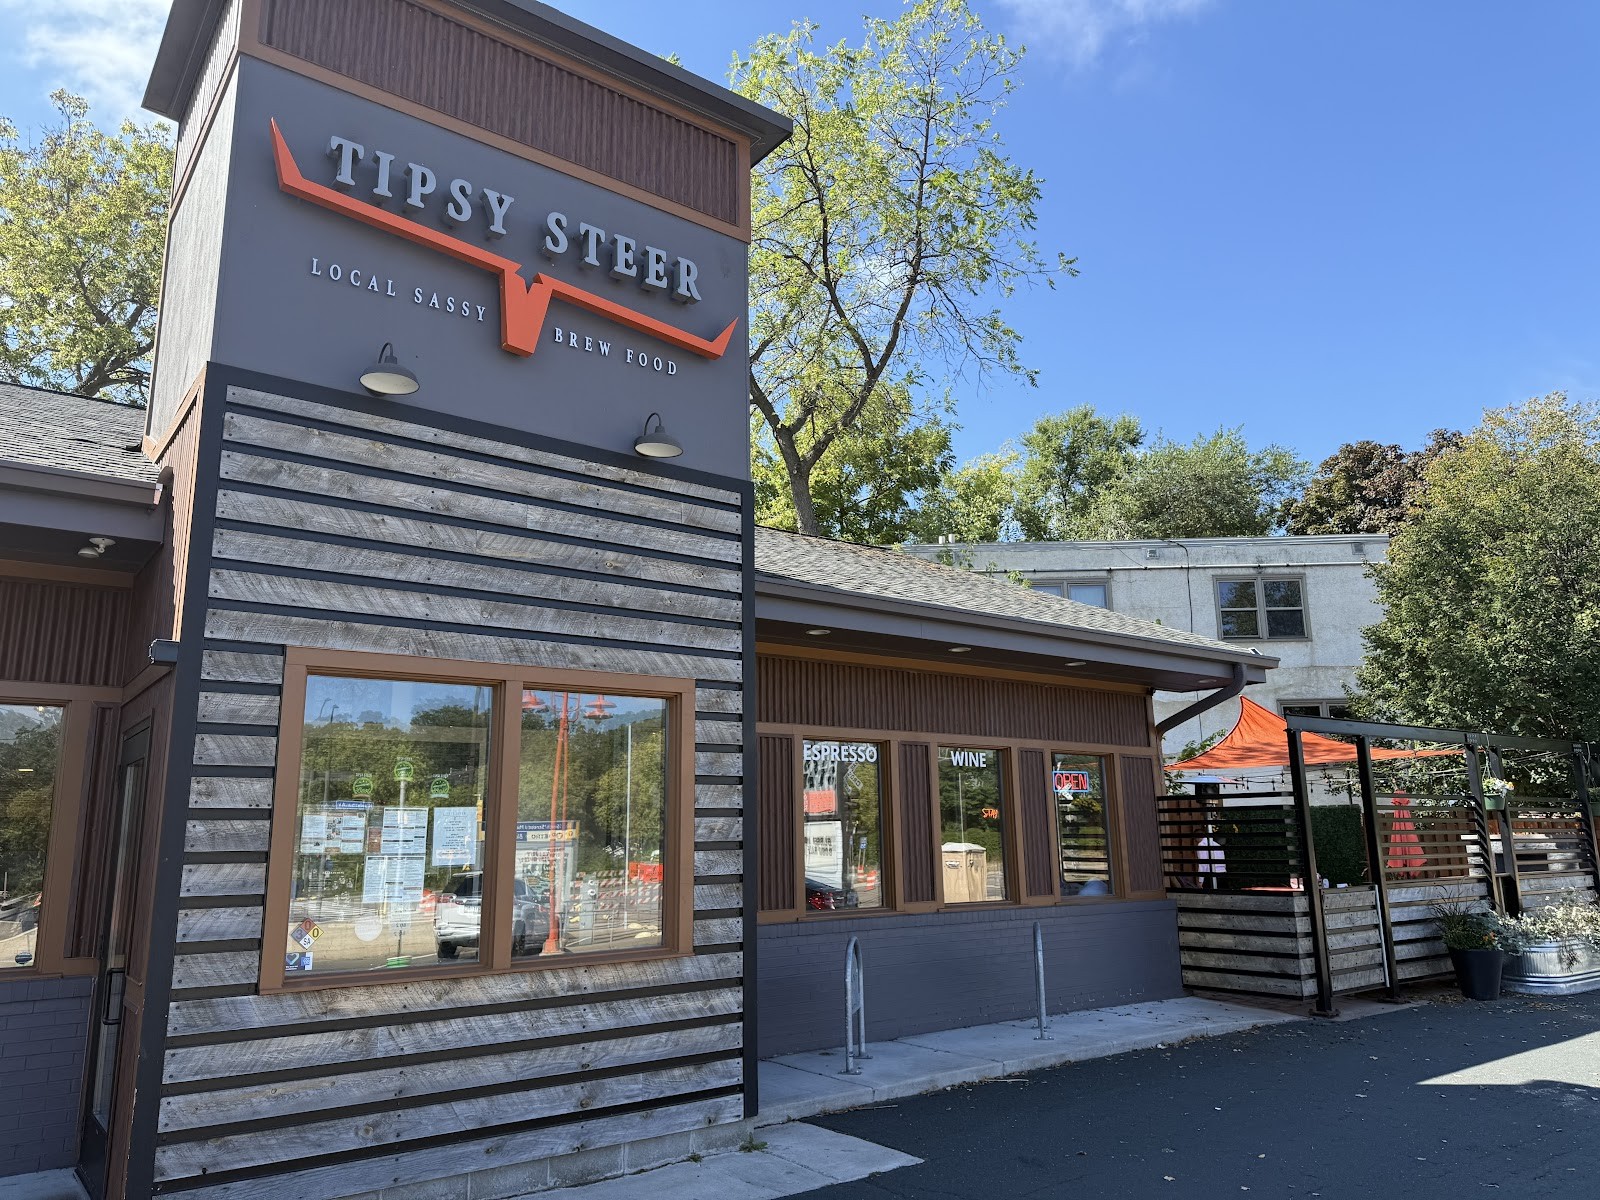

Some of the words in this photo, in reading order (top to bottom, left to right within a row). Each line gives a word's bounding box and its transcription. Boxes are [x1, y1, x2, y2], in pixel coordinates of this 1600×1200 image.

[328, 135, 515, 236] TIPSY
[544, 211, 702, 302] STEER
[311, 257, 396, 297] LOCAL
[414, 287, 486, 322] SASSY
[554, 327, 611, 357] BREW
[626, 348, 677, 375] FOOD
[803, 744, 878, 762] ESPRESSO
[950, 750, 987, 768] WINE
[1054, 773, 1088, 791] OPEN
[312, 927, 320, 938] 0
